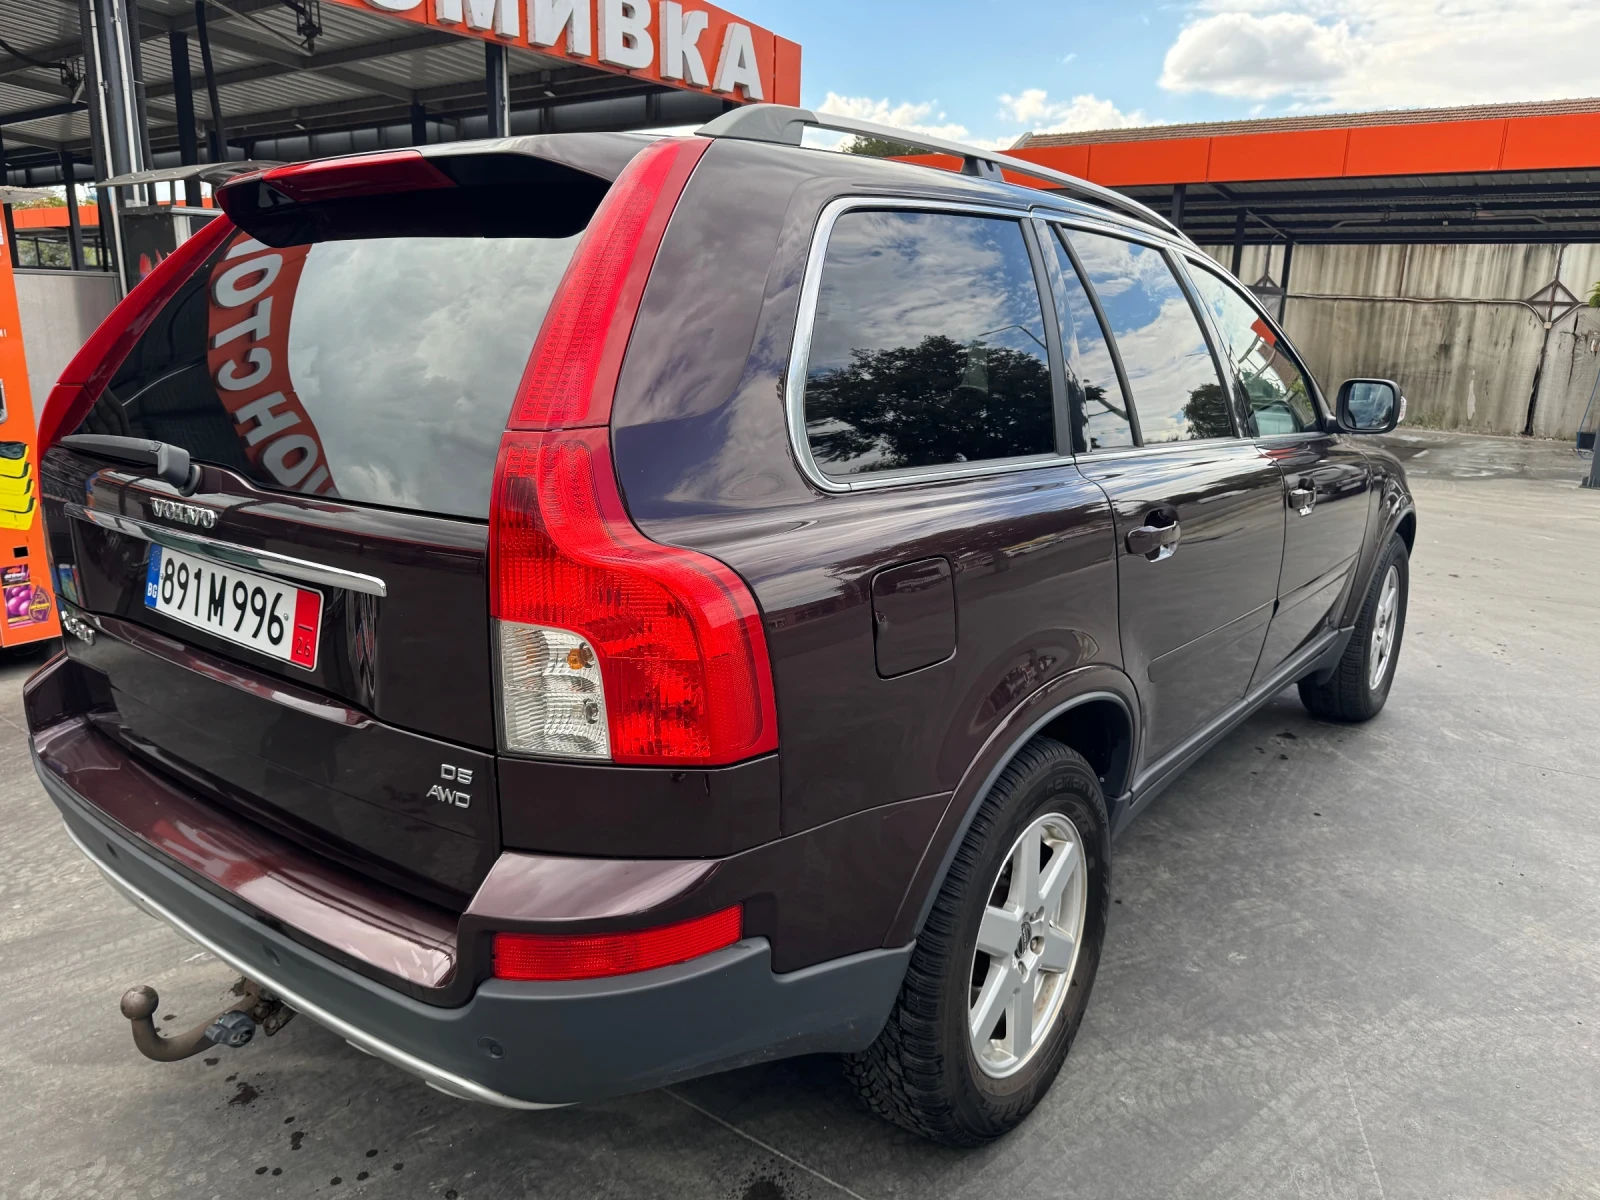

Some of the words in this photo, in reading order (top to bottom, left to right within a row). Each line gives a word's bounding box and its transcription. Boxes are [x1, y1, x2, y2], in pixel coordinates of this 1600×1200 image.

[362, 0, 764, 101] МИВКА
[150, 497, 218, 529] VOLVO
[147, 582, 158, 598] BG
[441, 763, 473, 785] D5
[426, 784, 471, 809] AWD
